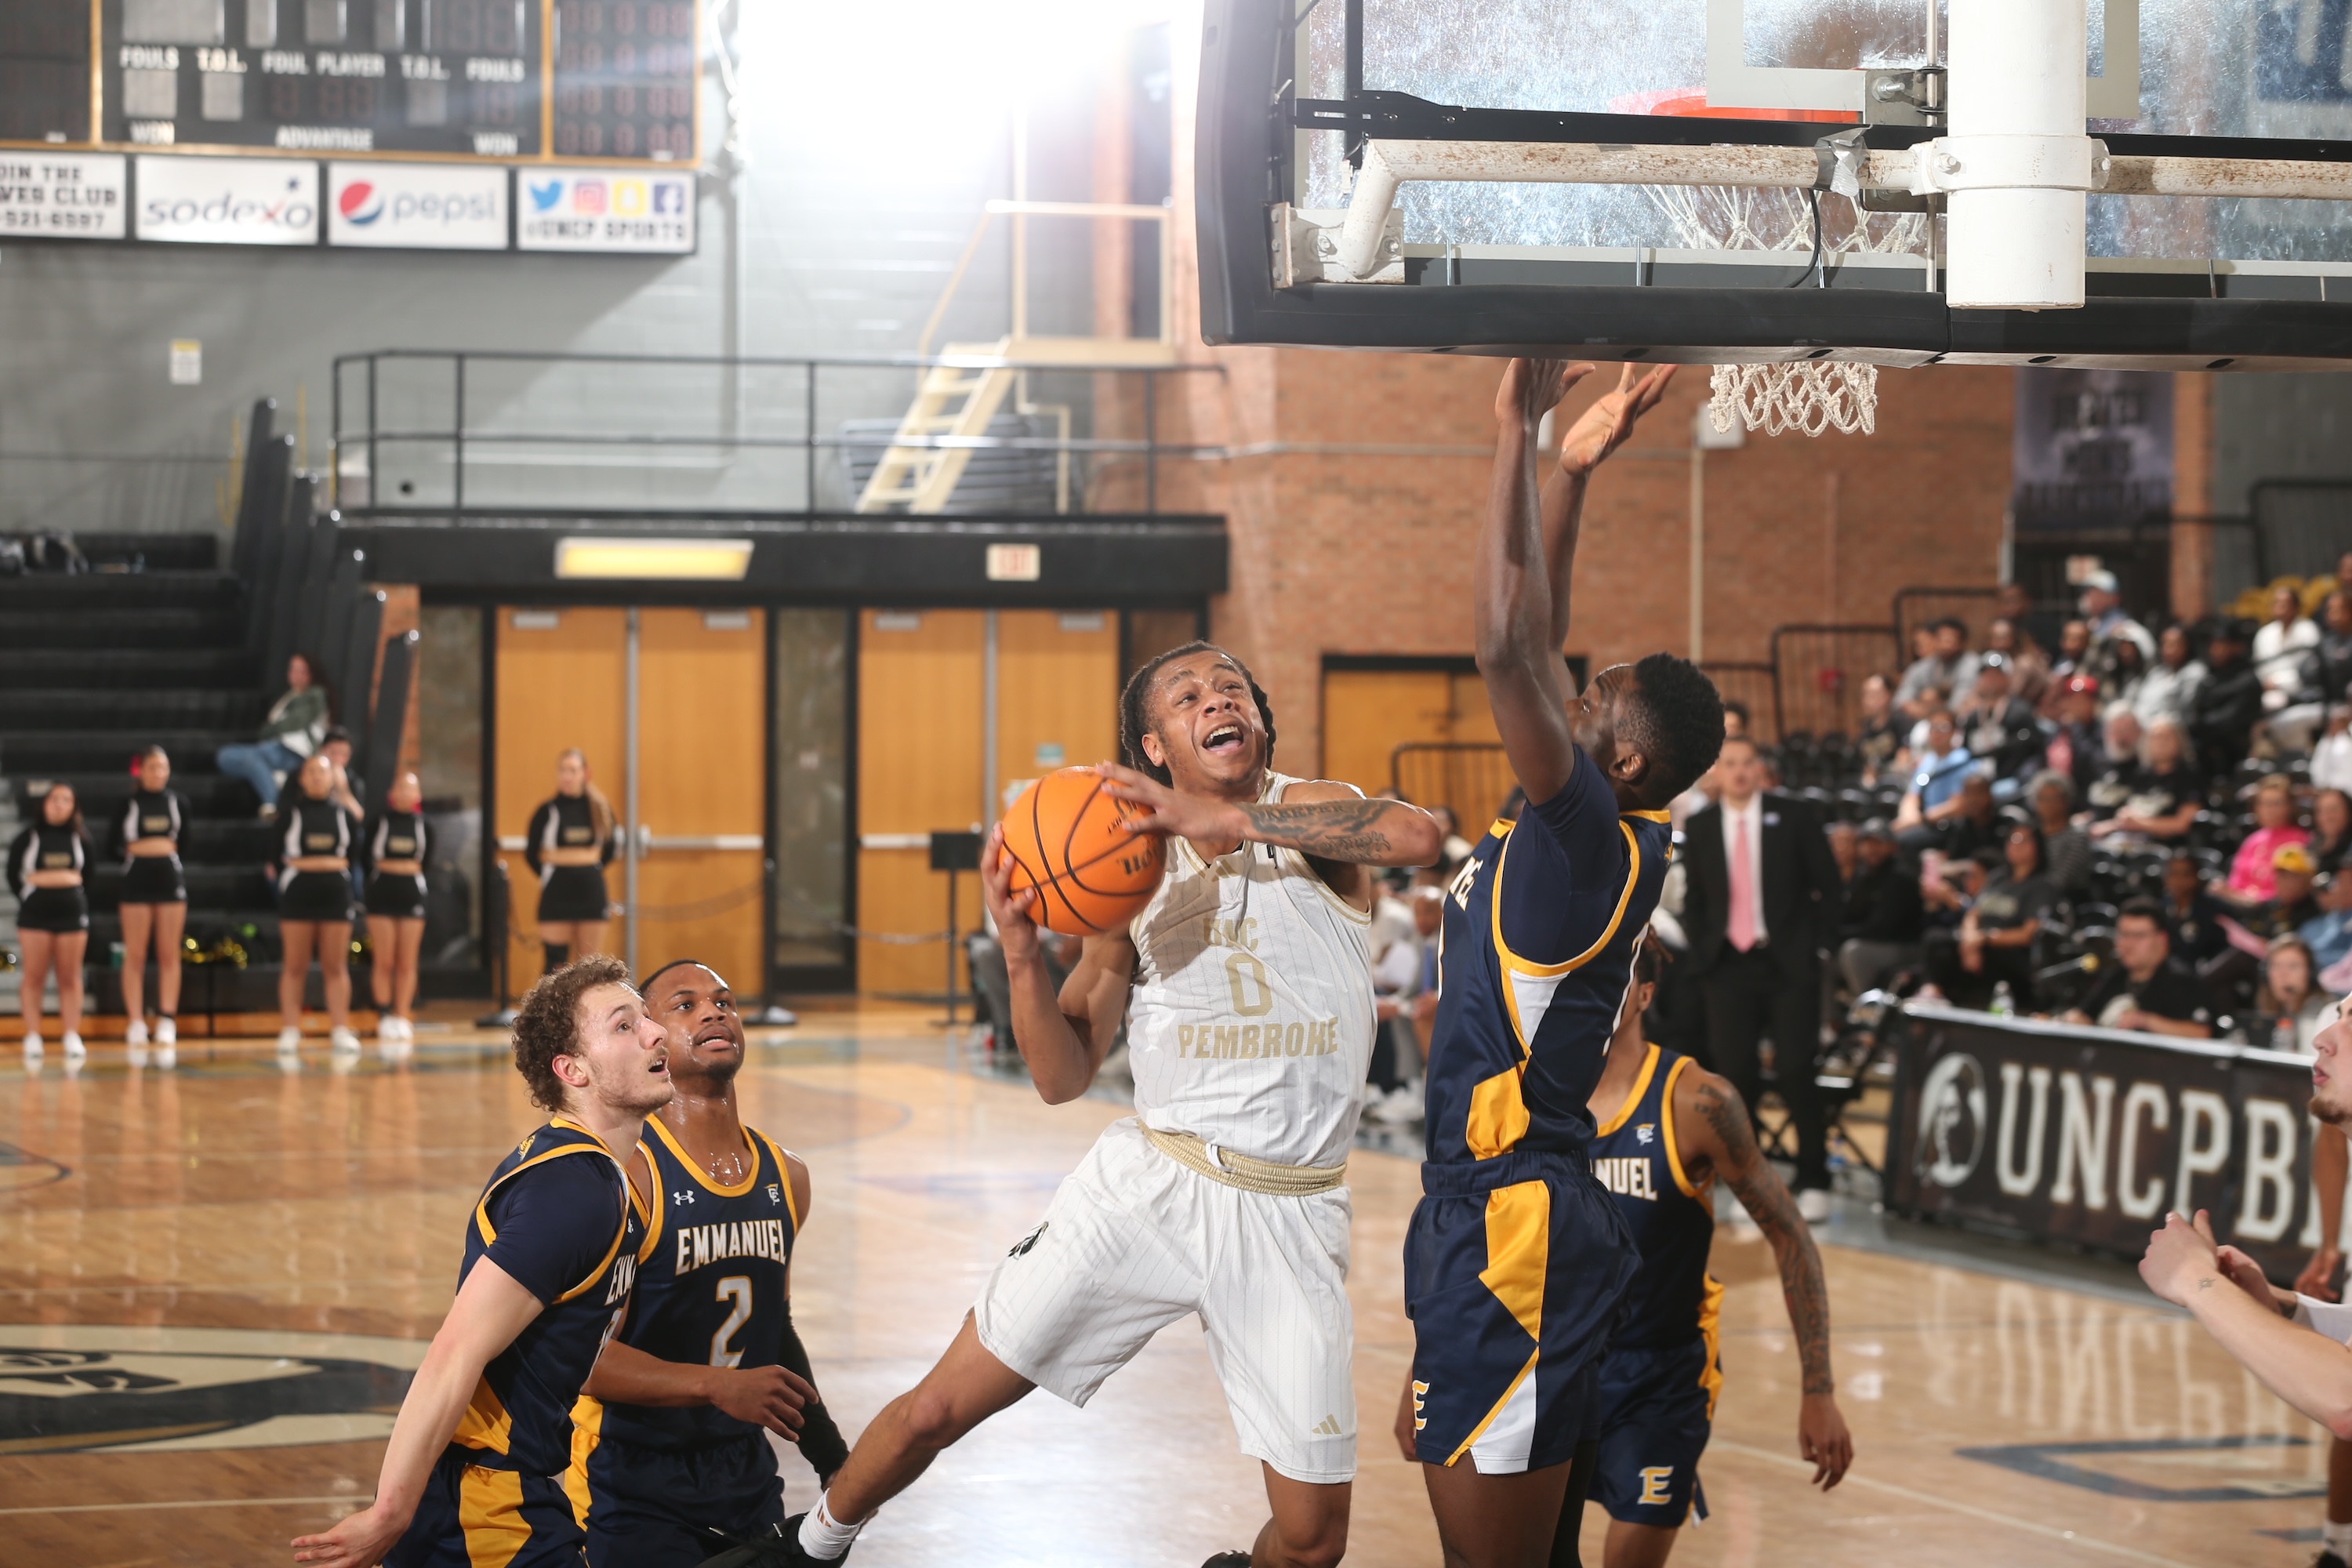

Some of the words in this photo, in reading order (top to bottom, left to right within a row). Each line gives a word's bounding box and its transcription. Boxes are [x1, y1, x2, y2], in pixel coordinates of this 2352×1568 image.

[120, 45, 180, 70] FOULS
[261, 50, 310, 74] FOUL
[315, 53, 386, 78] PLAYER
[466, 57, 525, 82] FOULS
[275, 125, 374, 151] ADVANTAGE
[42, 165, 82, 182] THE
[0, 186, 44, 205] VES
[55, 187, 117, 206] CLUB
[143, 189, 312, 229] sodexo
[392, 188, 497, 225] pepsi
[605, 220, 686, 241] SPORTS
[1203, 916, 1260, 952] UNC
[1225, 952, 1274, 1018] 0
[1178, 1016, 1339, 1060] PEMBROKE
[1590, 1157, 1658, 1202] NUEL
[675, 1219, 787, 1277] EMMANUEL
[708, 1275, 753, 1370] 2
[1637, 1466, 1674, 1505] E
